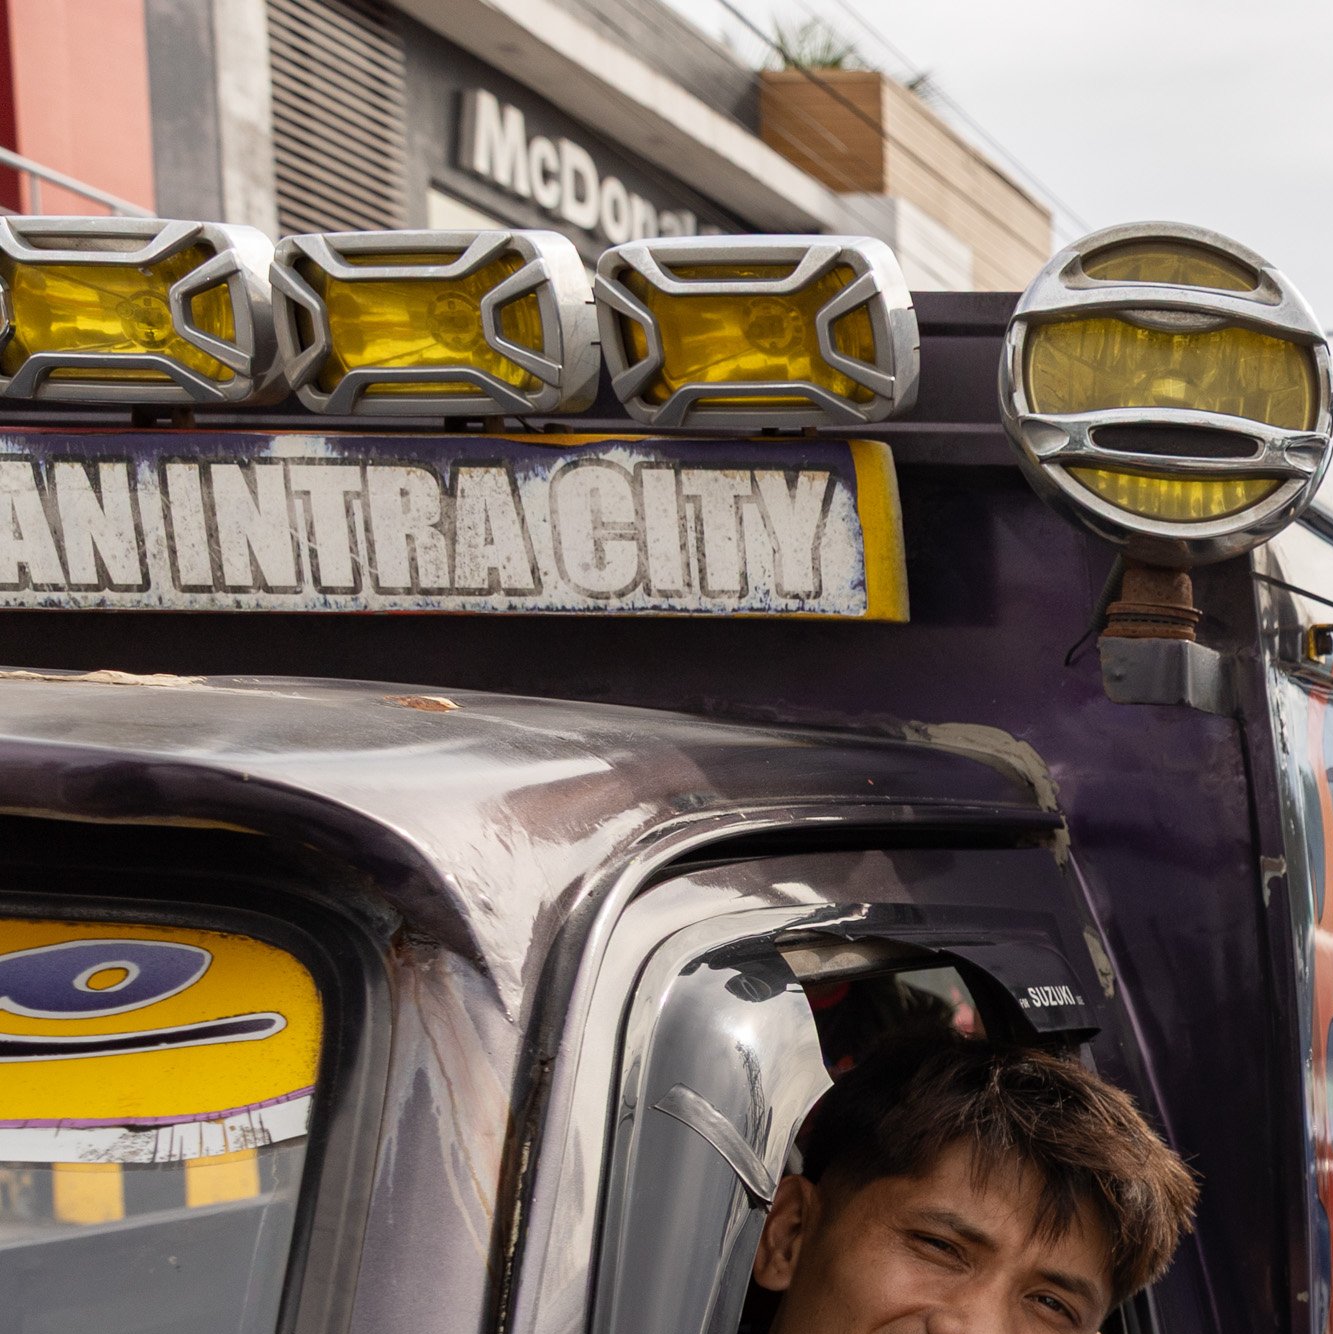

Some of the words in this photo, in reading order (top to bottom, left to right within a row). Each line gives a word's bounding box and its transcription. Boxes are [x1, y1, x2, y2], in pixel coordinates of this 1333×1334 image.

[158, 454, 544, 596] INTRA
[549, 458, 838, 600] CITY
[1027, 985, 1077, 1008] SUZUKI
